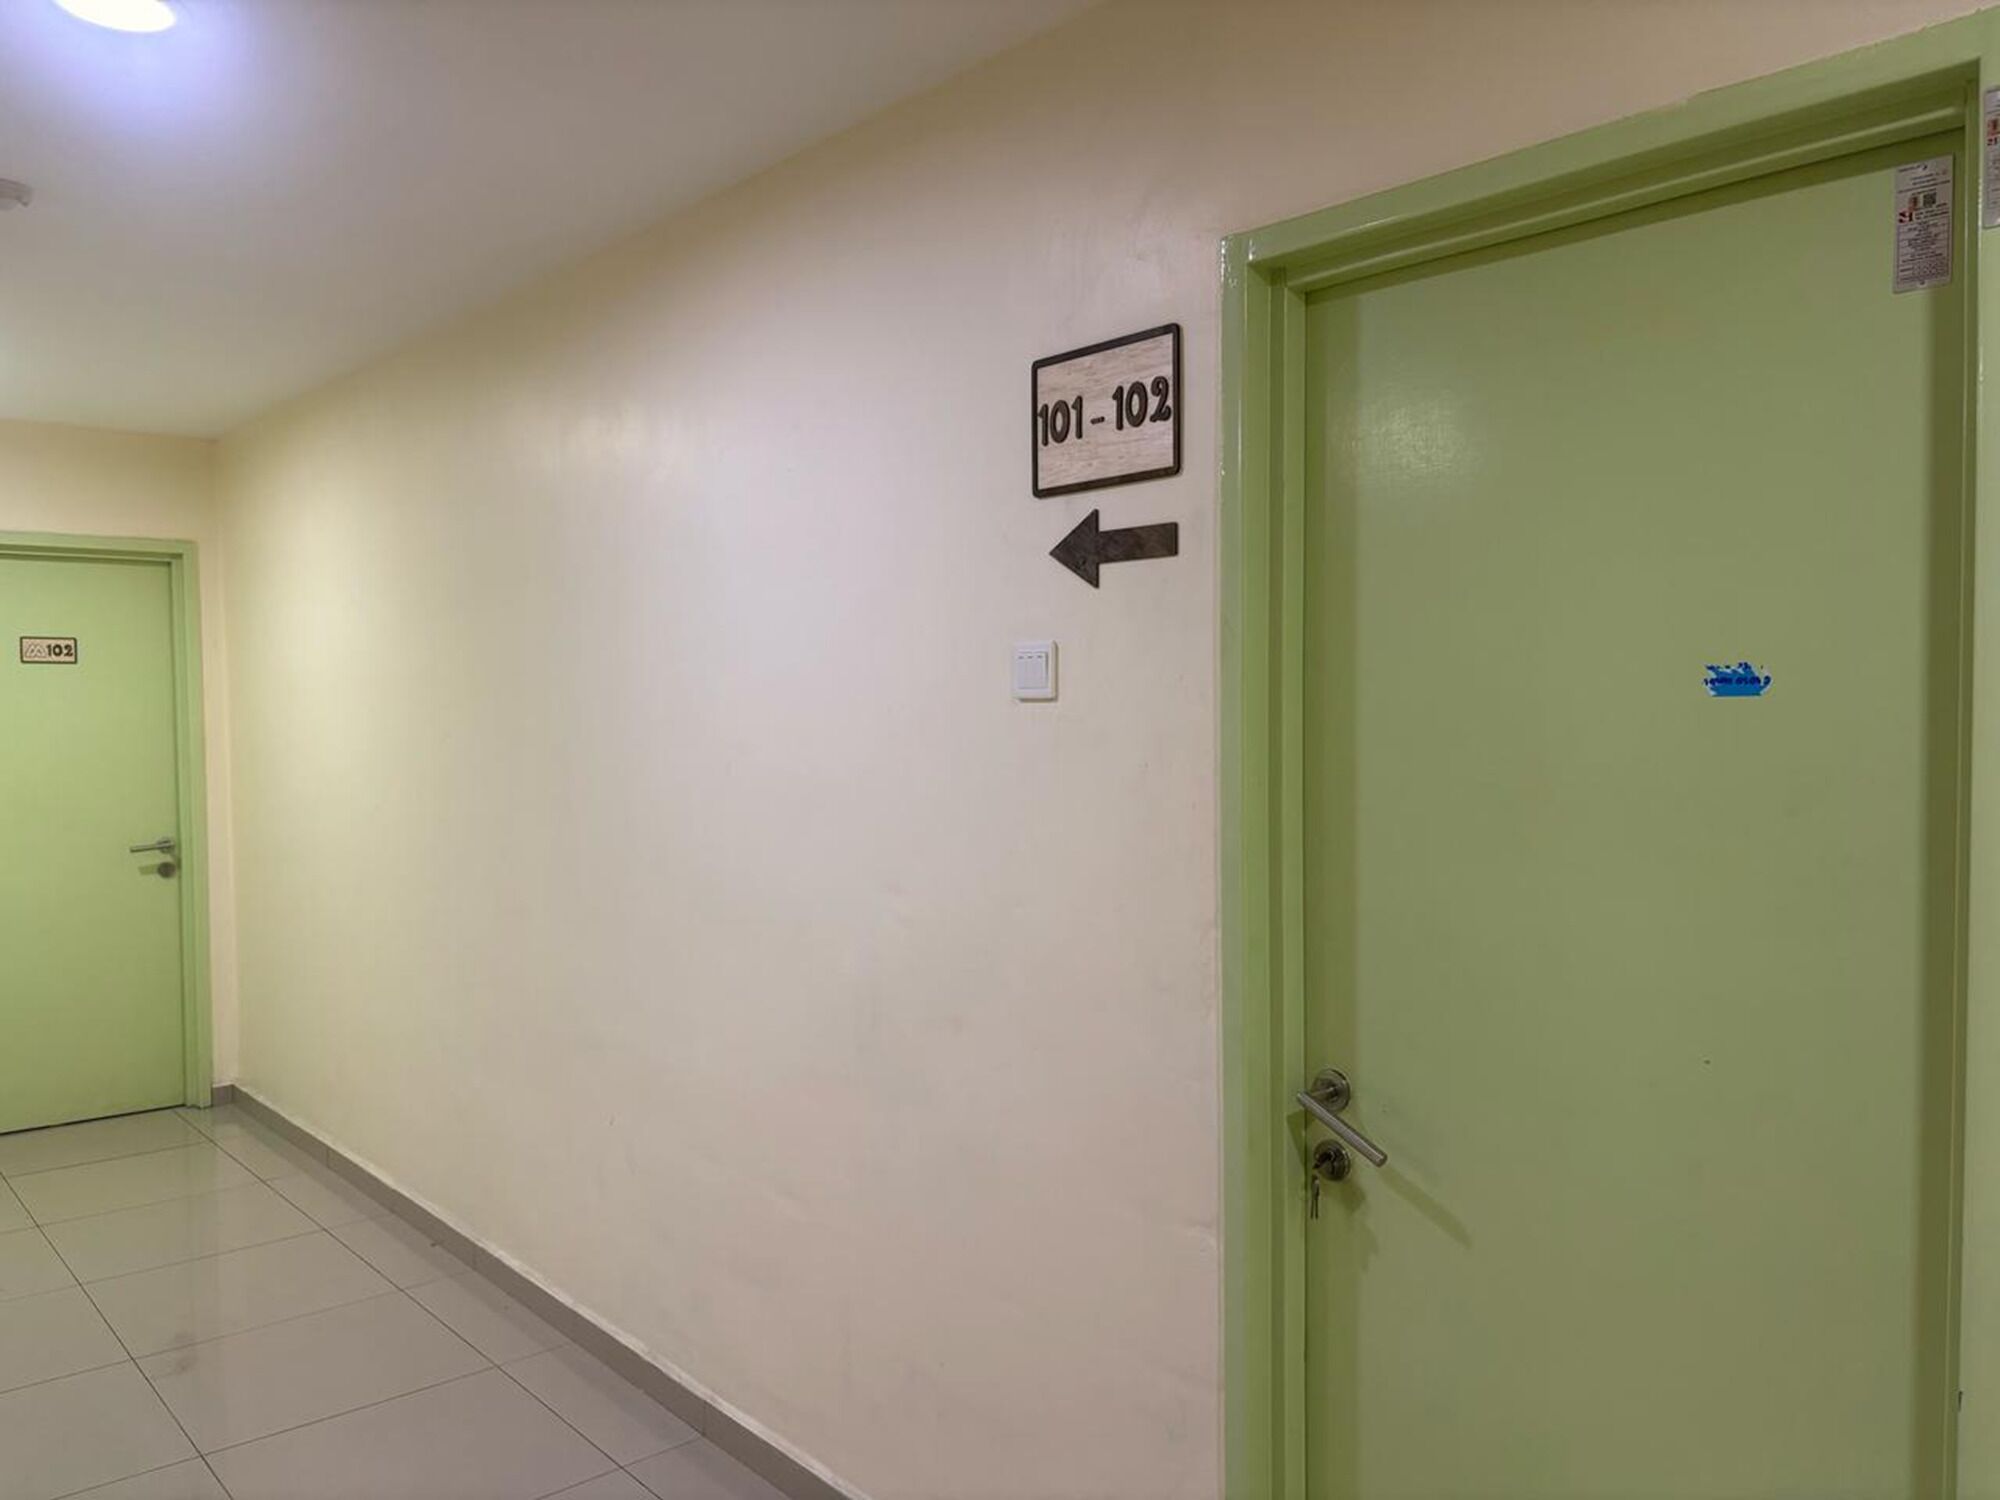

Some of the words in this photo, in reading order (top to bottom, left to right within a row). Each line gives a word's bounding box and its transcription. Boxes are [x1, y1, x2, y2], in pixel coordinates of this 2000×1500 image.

[1038, 395, 1083, 447] 101
[1112, 376, 1172, 431] 102
[46, 644, 73, 657] 102
